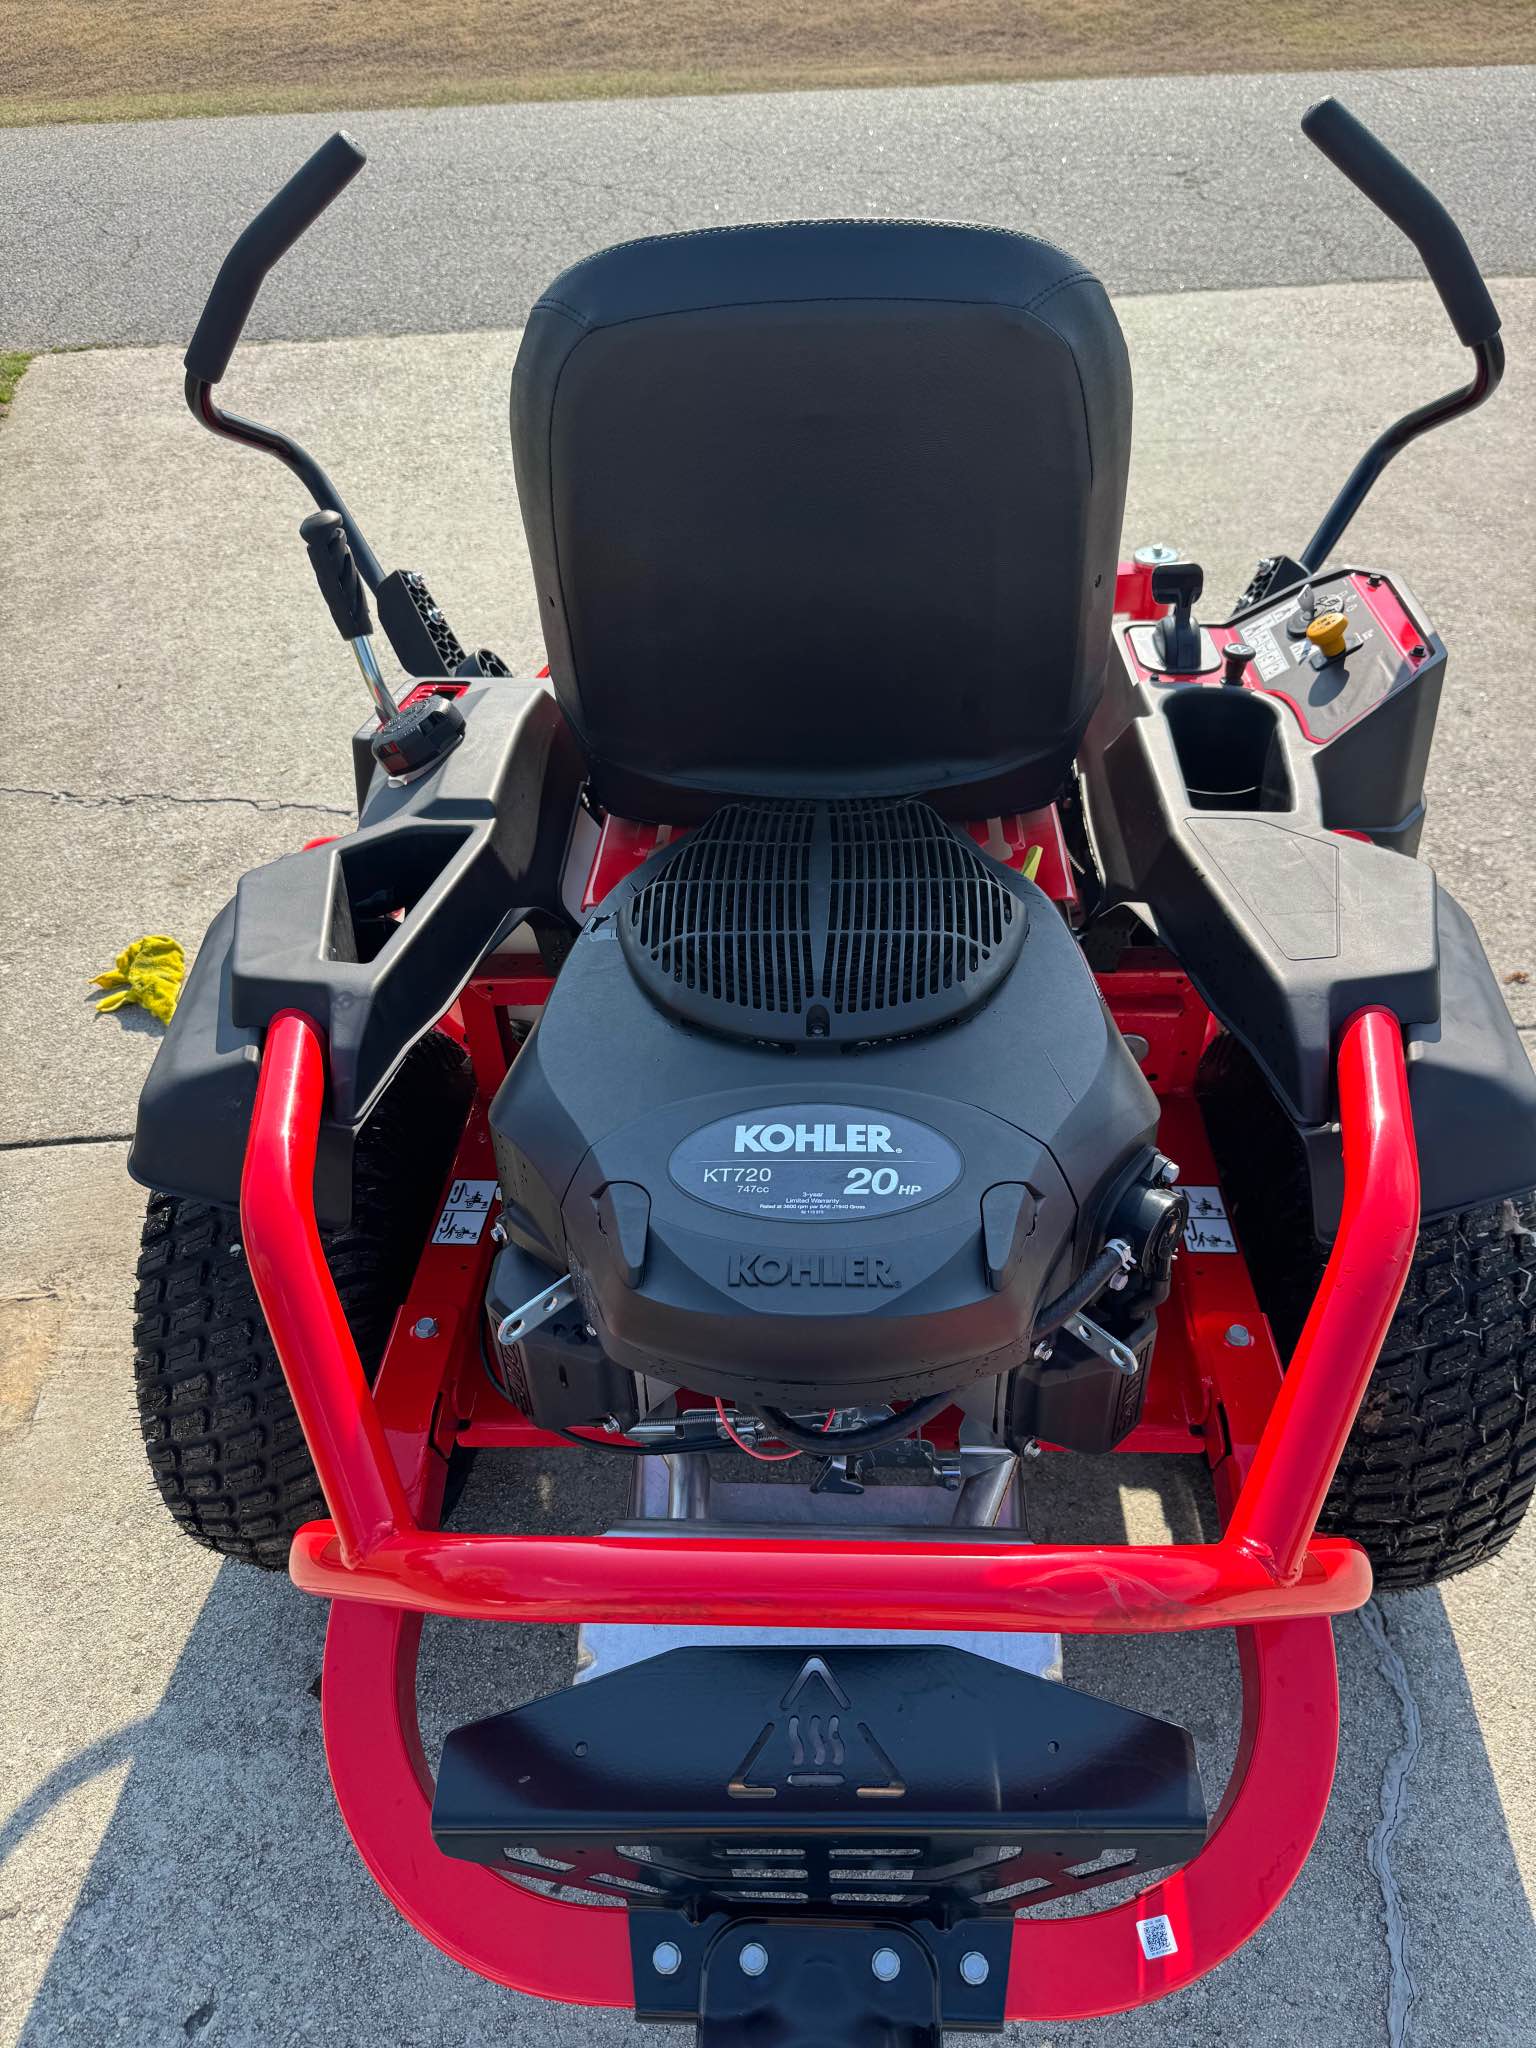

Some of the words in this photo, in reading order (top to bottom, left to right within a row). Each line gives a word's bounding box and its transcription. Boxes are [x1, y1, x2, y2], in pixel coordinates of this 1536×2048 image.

[703, 1167, 772, 1183] KT720
[843, 1167, 899, 1195] 20
[898, 1185, 922, 1195] HP
[737, 1185, 770, 1193] 747cc
